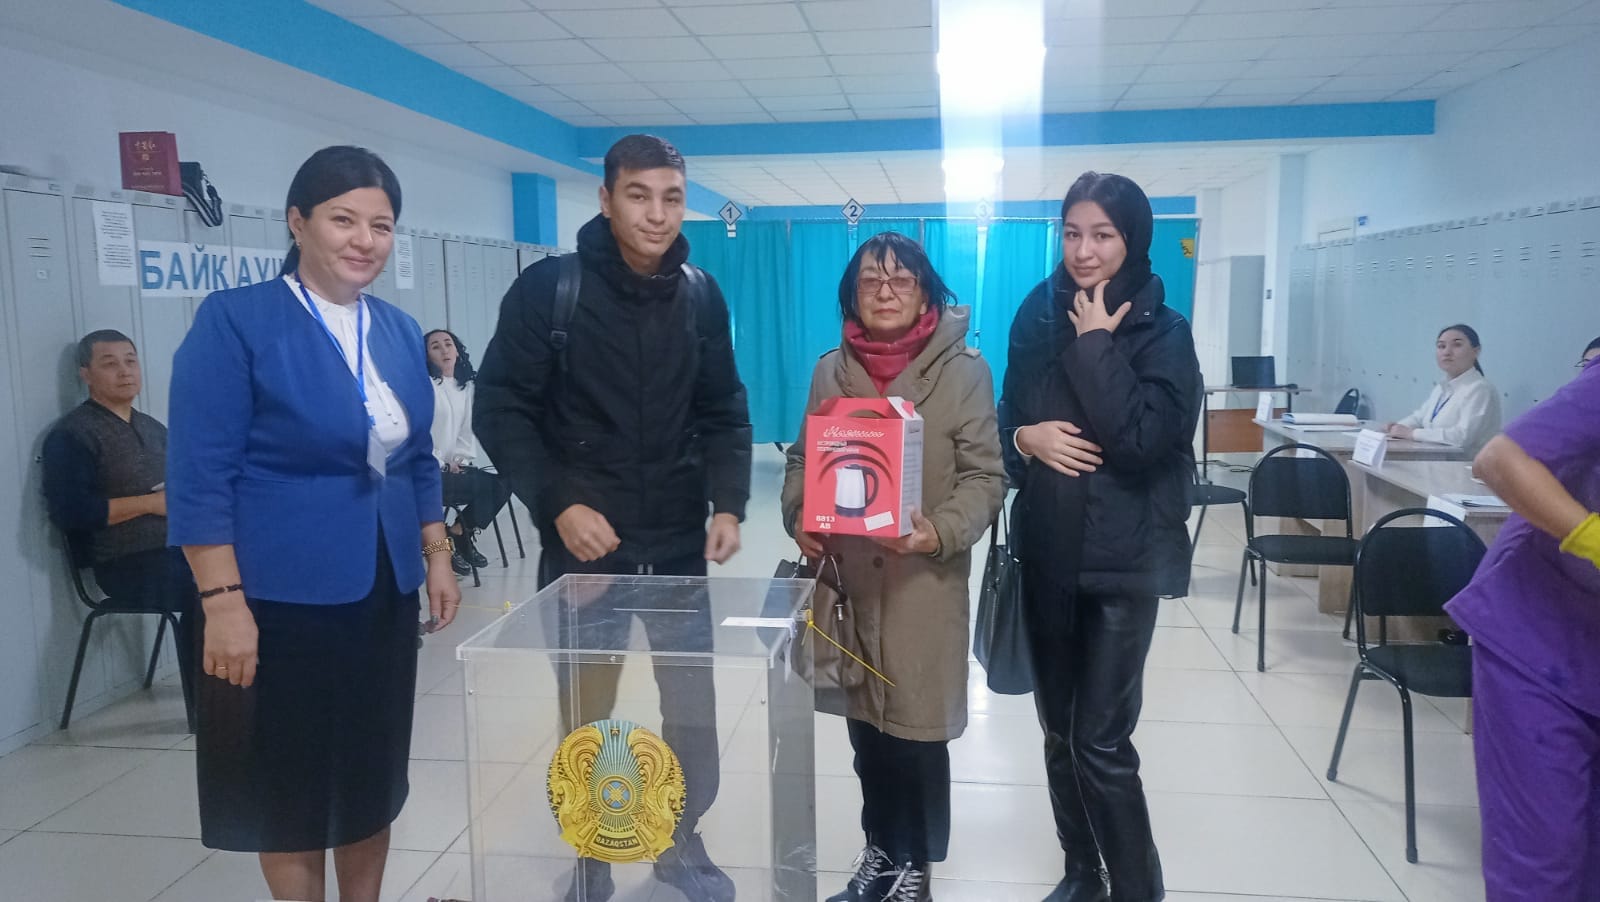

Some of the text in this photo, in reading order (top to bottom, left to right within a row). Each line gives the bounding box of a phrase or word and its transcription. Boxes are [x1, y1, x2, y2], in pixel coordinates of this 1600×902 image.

[726, 207, 732, 218] 1
[849, 204, 858, 217] 2
[979, 204, 987, 217] 3
[596, 836, 638, 848] QAZAQSTAN
